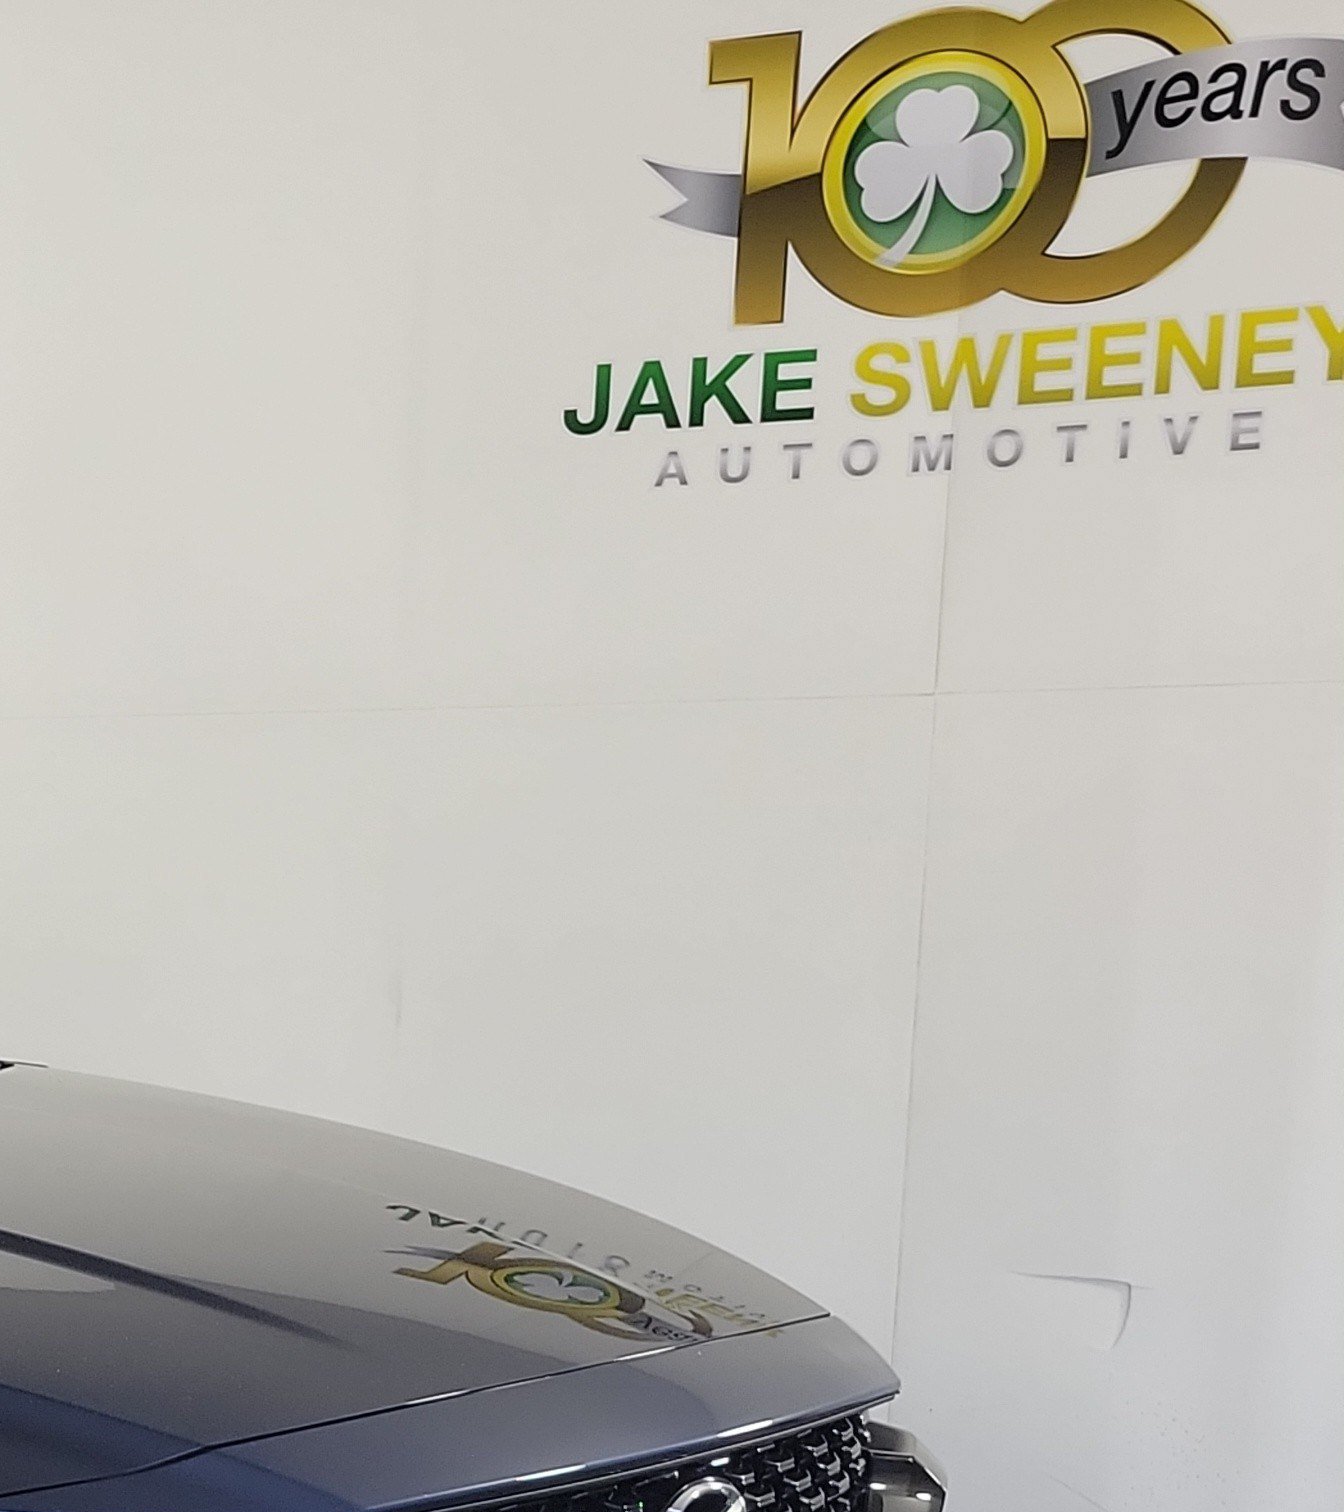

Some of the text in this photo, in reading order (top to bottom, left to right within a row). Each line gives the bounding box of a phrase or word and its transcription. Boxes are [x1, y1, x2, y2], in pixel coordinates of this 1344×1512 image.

[1105, 57, 1325, 159] years
[563, 349, 818, 436] JAKE
[655, 411, 1263, 487] AUTOMOTIVE
